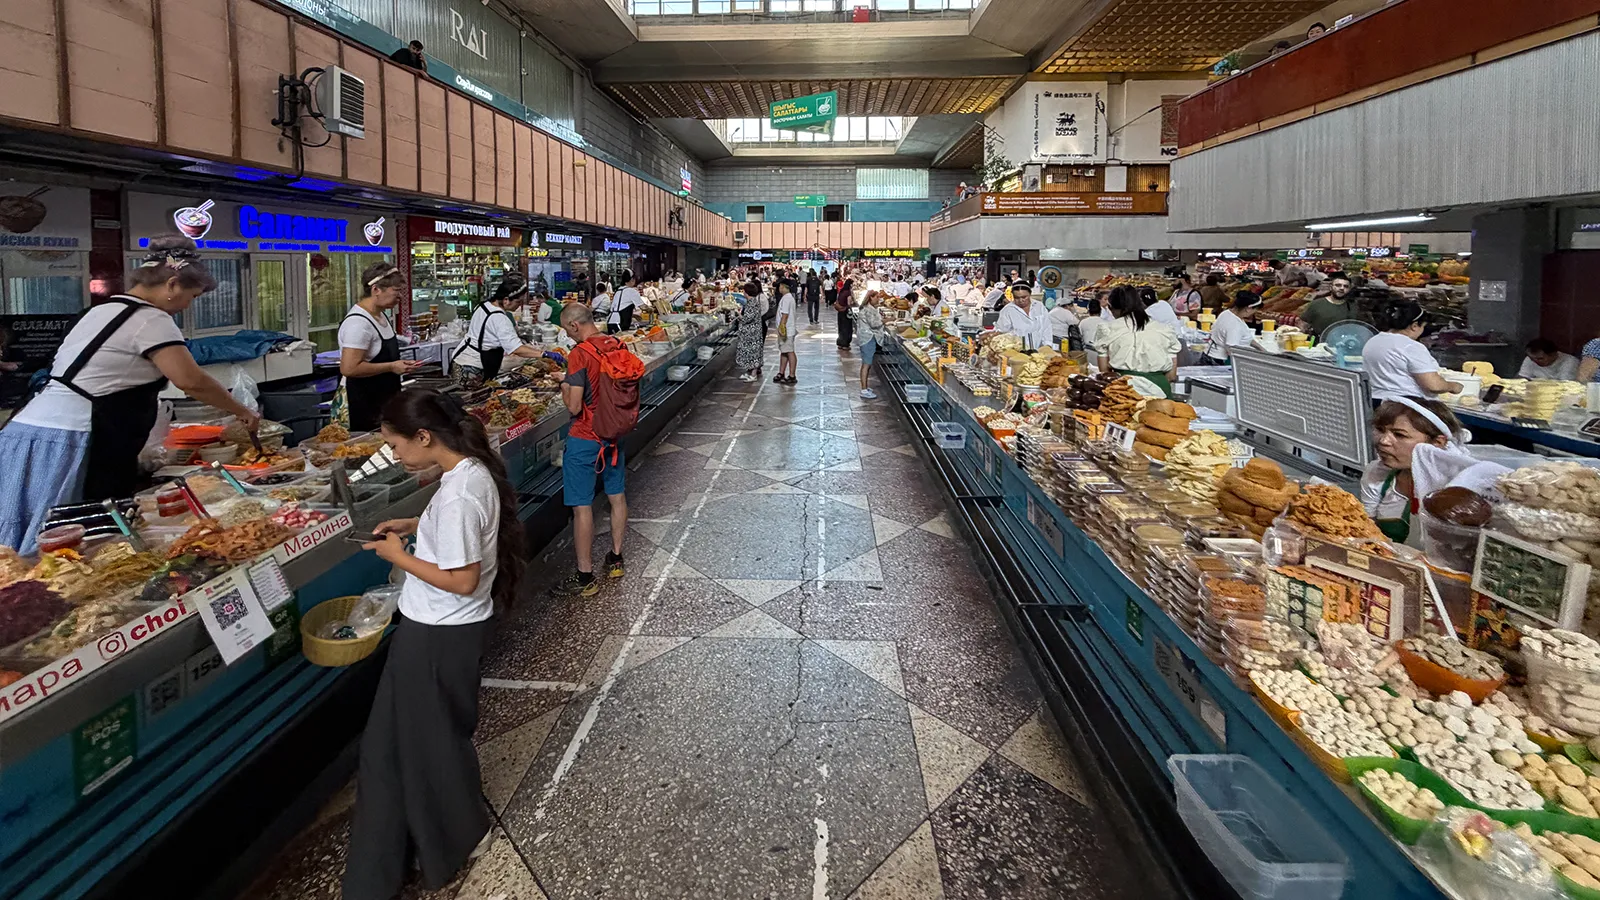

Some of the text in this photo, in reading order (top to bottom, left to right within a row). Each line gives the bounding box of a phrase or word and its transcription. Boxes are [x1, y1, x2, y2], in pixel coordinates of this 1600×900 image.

[449, 8, 487, 60] RAI
[239, 205, 348, 242] Саламат
[435, 221, 511, 238] ПРОДУКТОВЫЙ РАЙ
[505, 420, 532, 440] Светлана
[283, 514, 350, 557] Марина
[91, 720, 121, 746] POS
